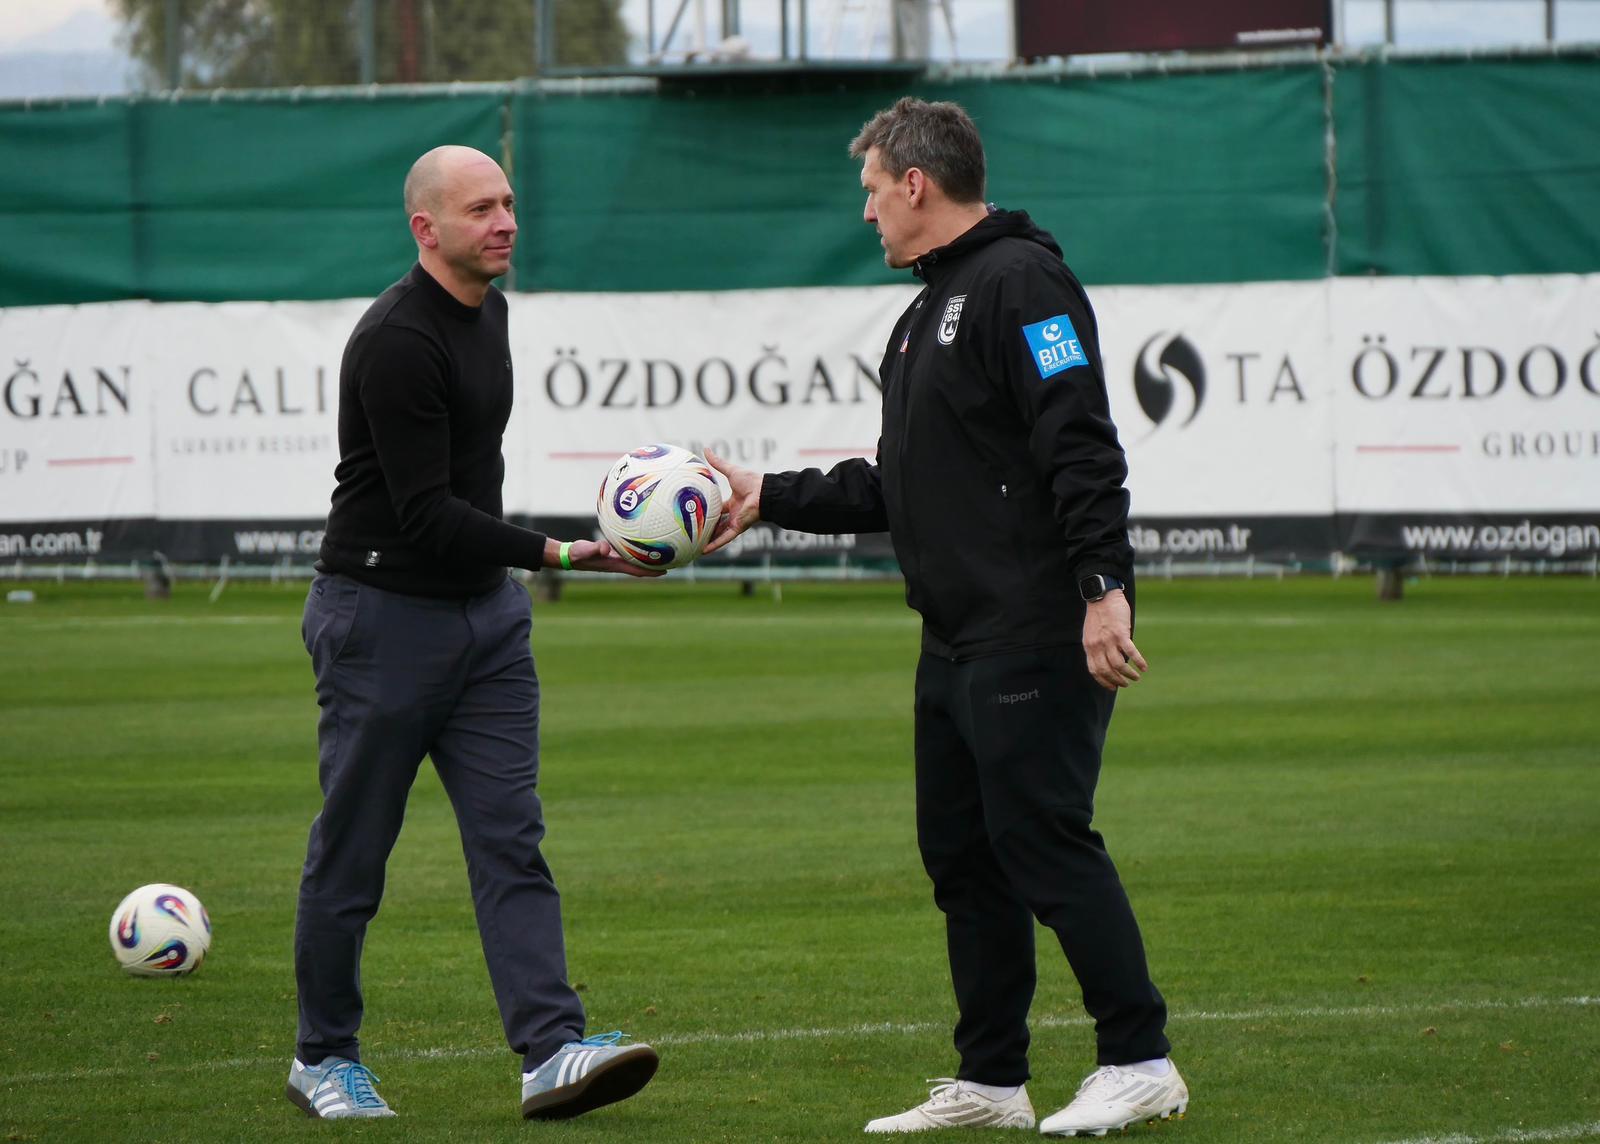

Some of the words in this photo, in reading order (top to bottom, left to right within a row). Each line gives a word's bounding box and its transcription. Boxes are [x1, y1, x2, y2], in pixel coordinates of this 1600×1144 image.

[1038, 339, 1081, 367] BITE
[3, 359, 130, 419] ĞAN
[188, 366, 326, 415] CALI
[545, 346, 883, 410] ÖZDOĞAN
[676, 437, 778, 463] ROUP
[1402, 519, 1600, 557] www.ozdogan
[985, 688, 1040, 704] lsport
